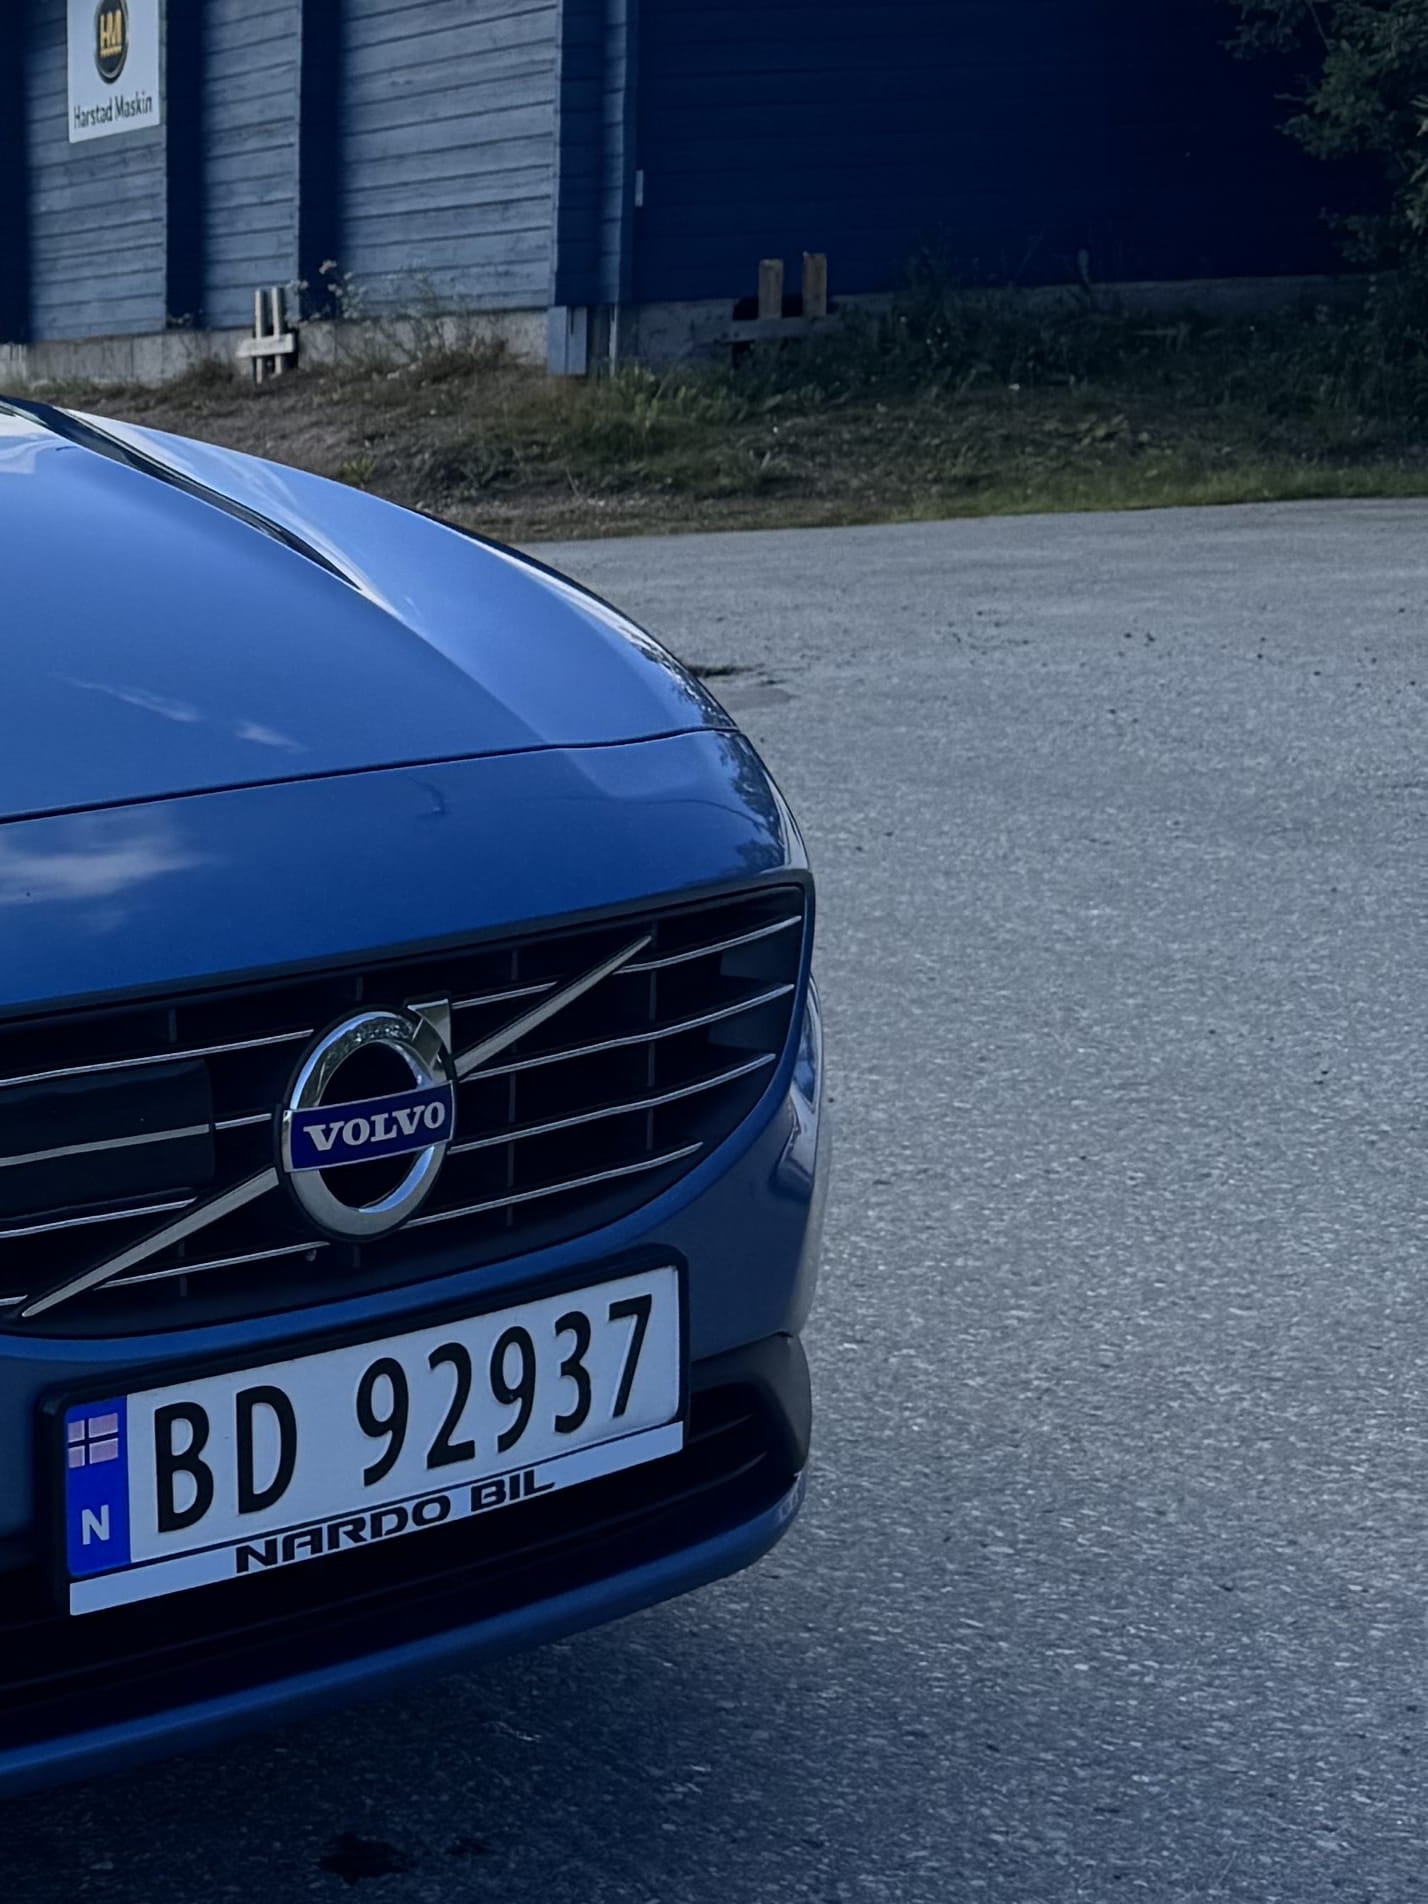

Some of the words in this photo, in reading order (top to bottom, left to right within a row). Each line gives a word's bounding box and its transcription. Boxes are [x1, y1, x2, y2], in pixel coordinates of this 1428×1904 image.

[73, 97, 113, 130] Harstad
[114, 90, 153, 121] Maskin
[302, 1101, 445, 1152] VOLVO
[153, 1384, 297, 1534] BD
[355, 1294, 653, 1487] 92937
[80, 1504, 110, 1546] N
[235, 1496, 451, 1574] NARDO
[470, 1467, 556, 1511] BIL
